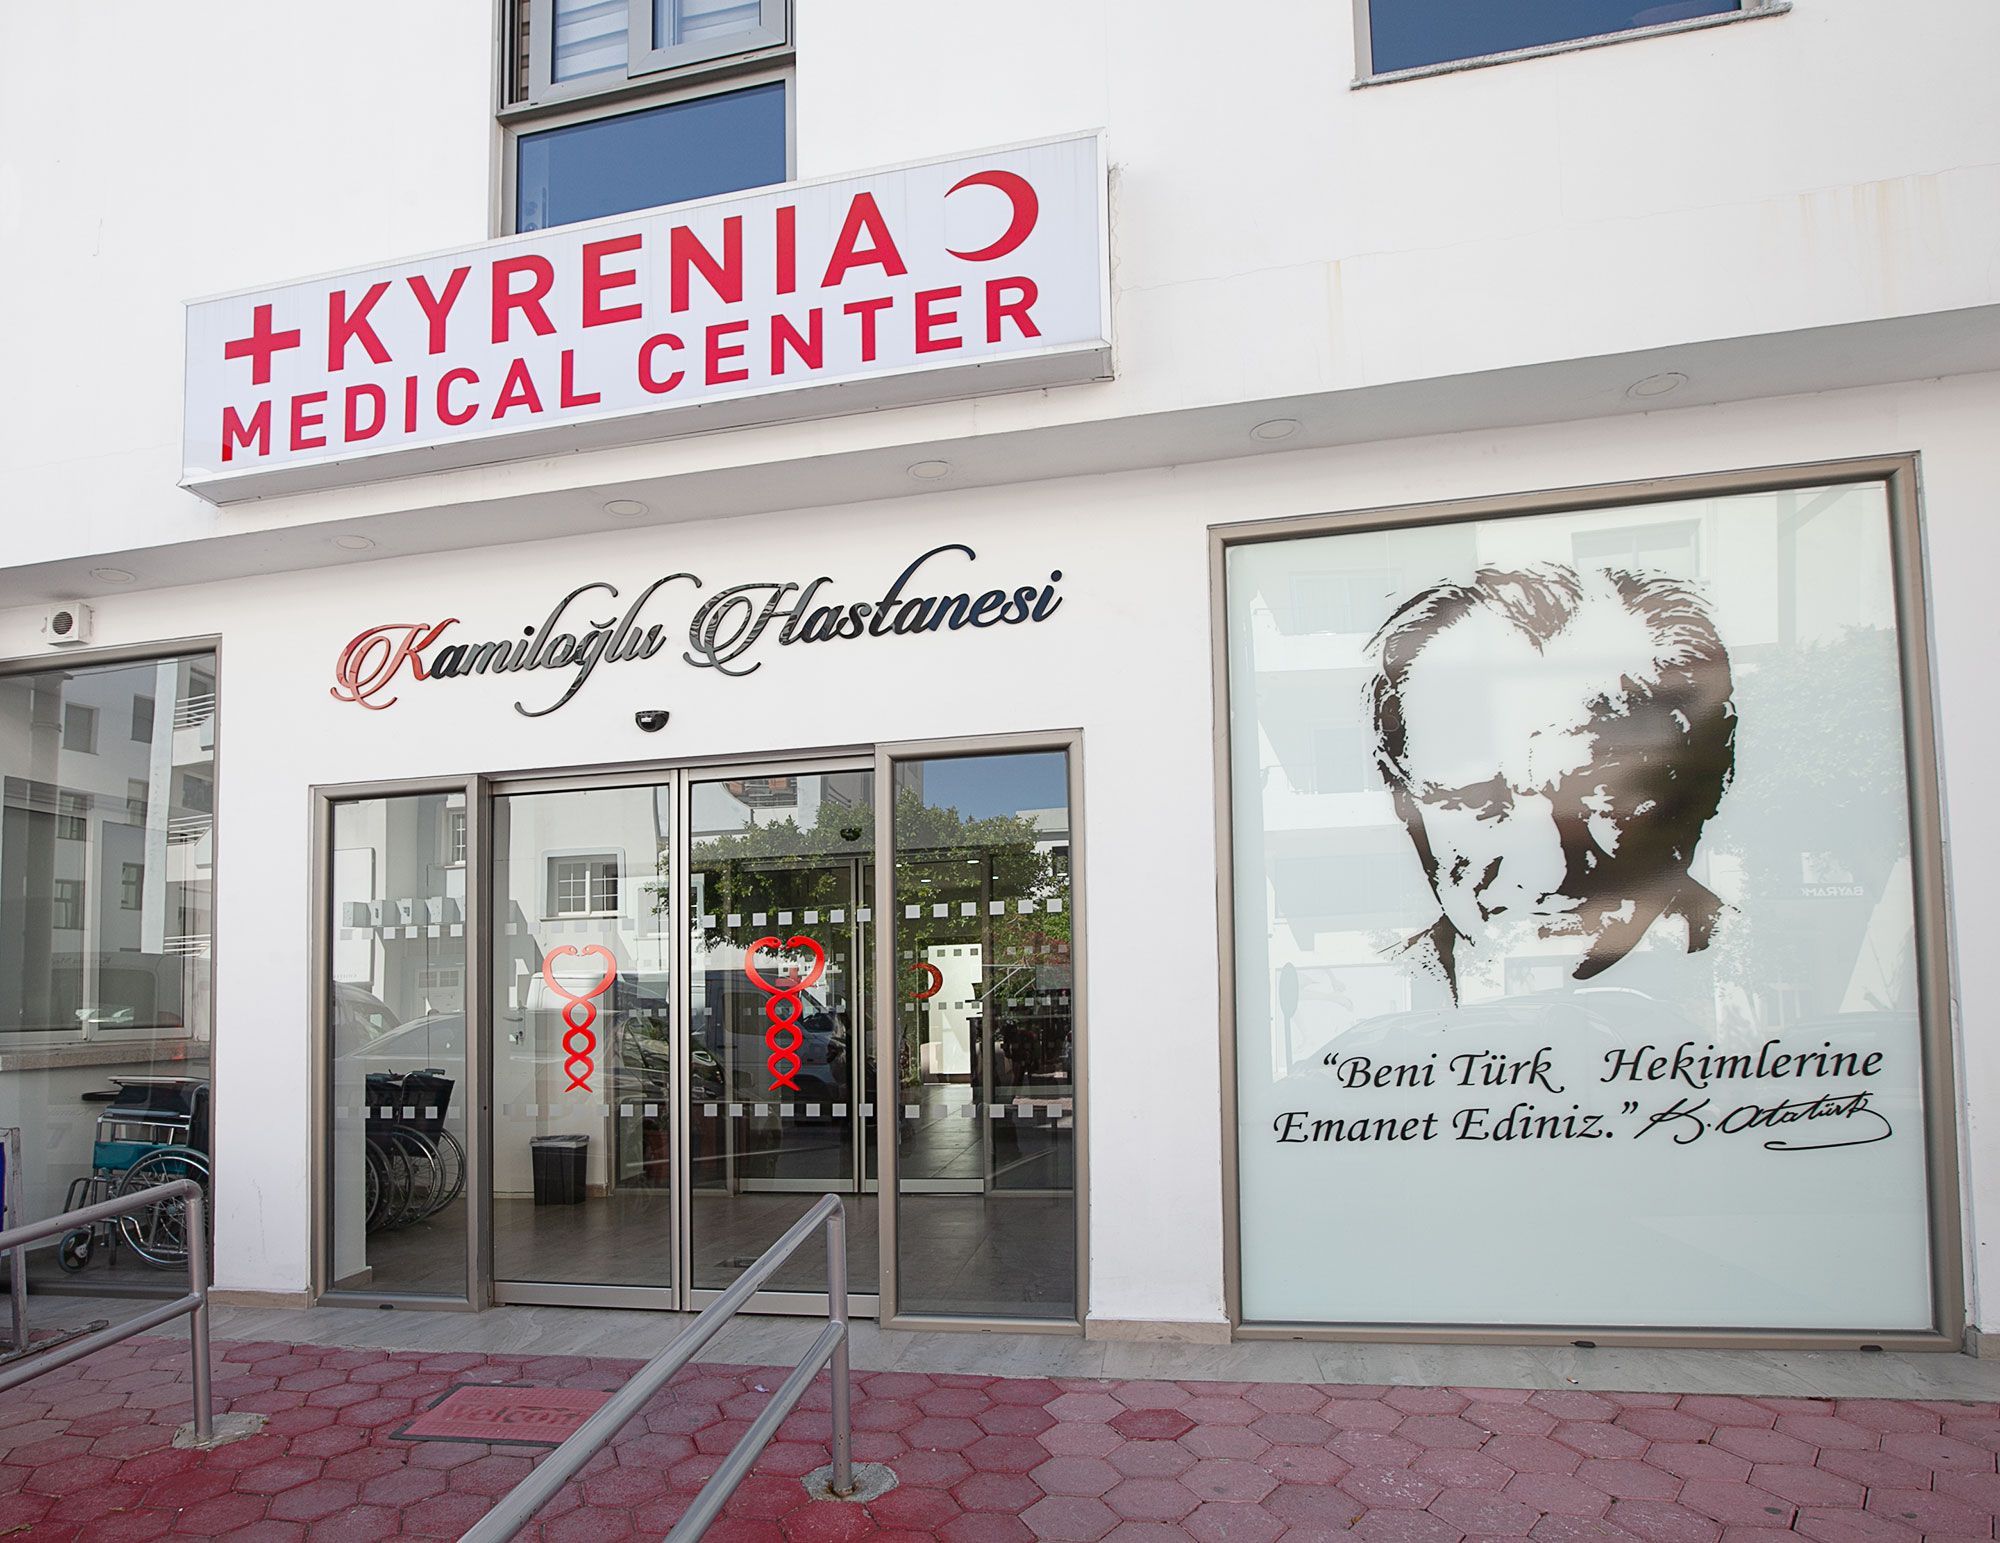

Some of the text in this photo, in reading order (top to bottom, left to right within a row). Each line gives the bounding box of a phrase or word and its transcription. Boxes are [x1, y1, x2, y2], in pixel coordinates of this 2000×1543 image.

[328, 192, 907, 372] KYRENIA
[222, 277, 1040, 462] MEDICAL CENTER
[330, 544, 1063, 717] Kamiloğlu Hastanesi
[1450, 1047, 1564, 1093] Türk
[1600, 1040, 1883, 1089] Hekimlerine
[1274, 1112, 1438, 1142] Emanet
[443, 1403, 586, 1426] Welcom
